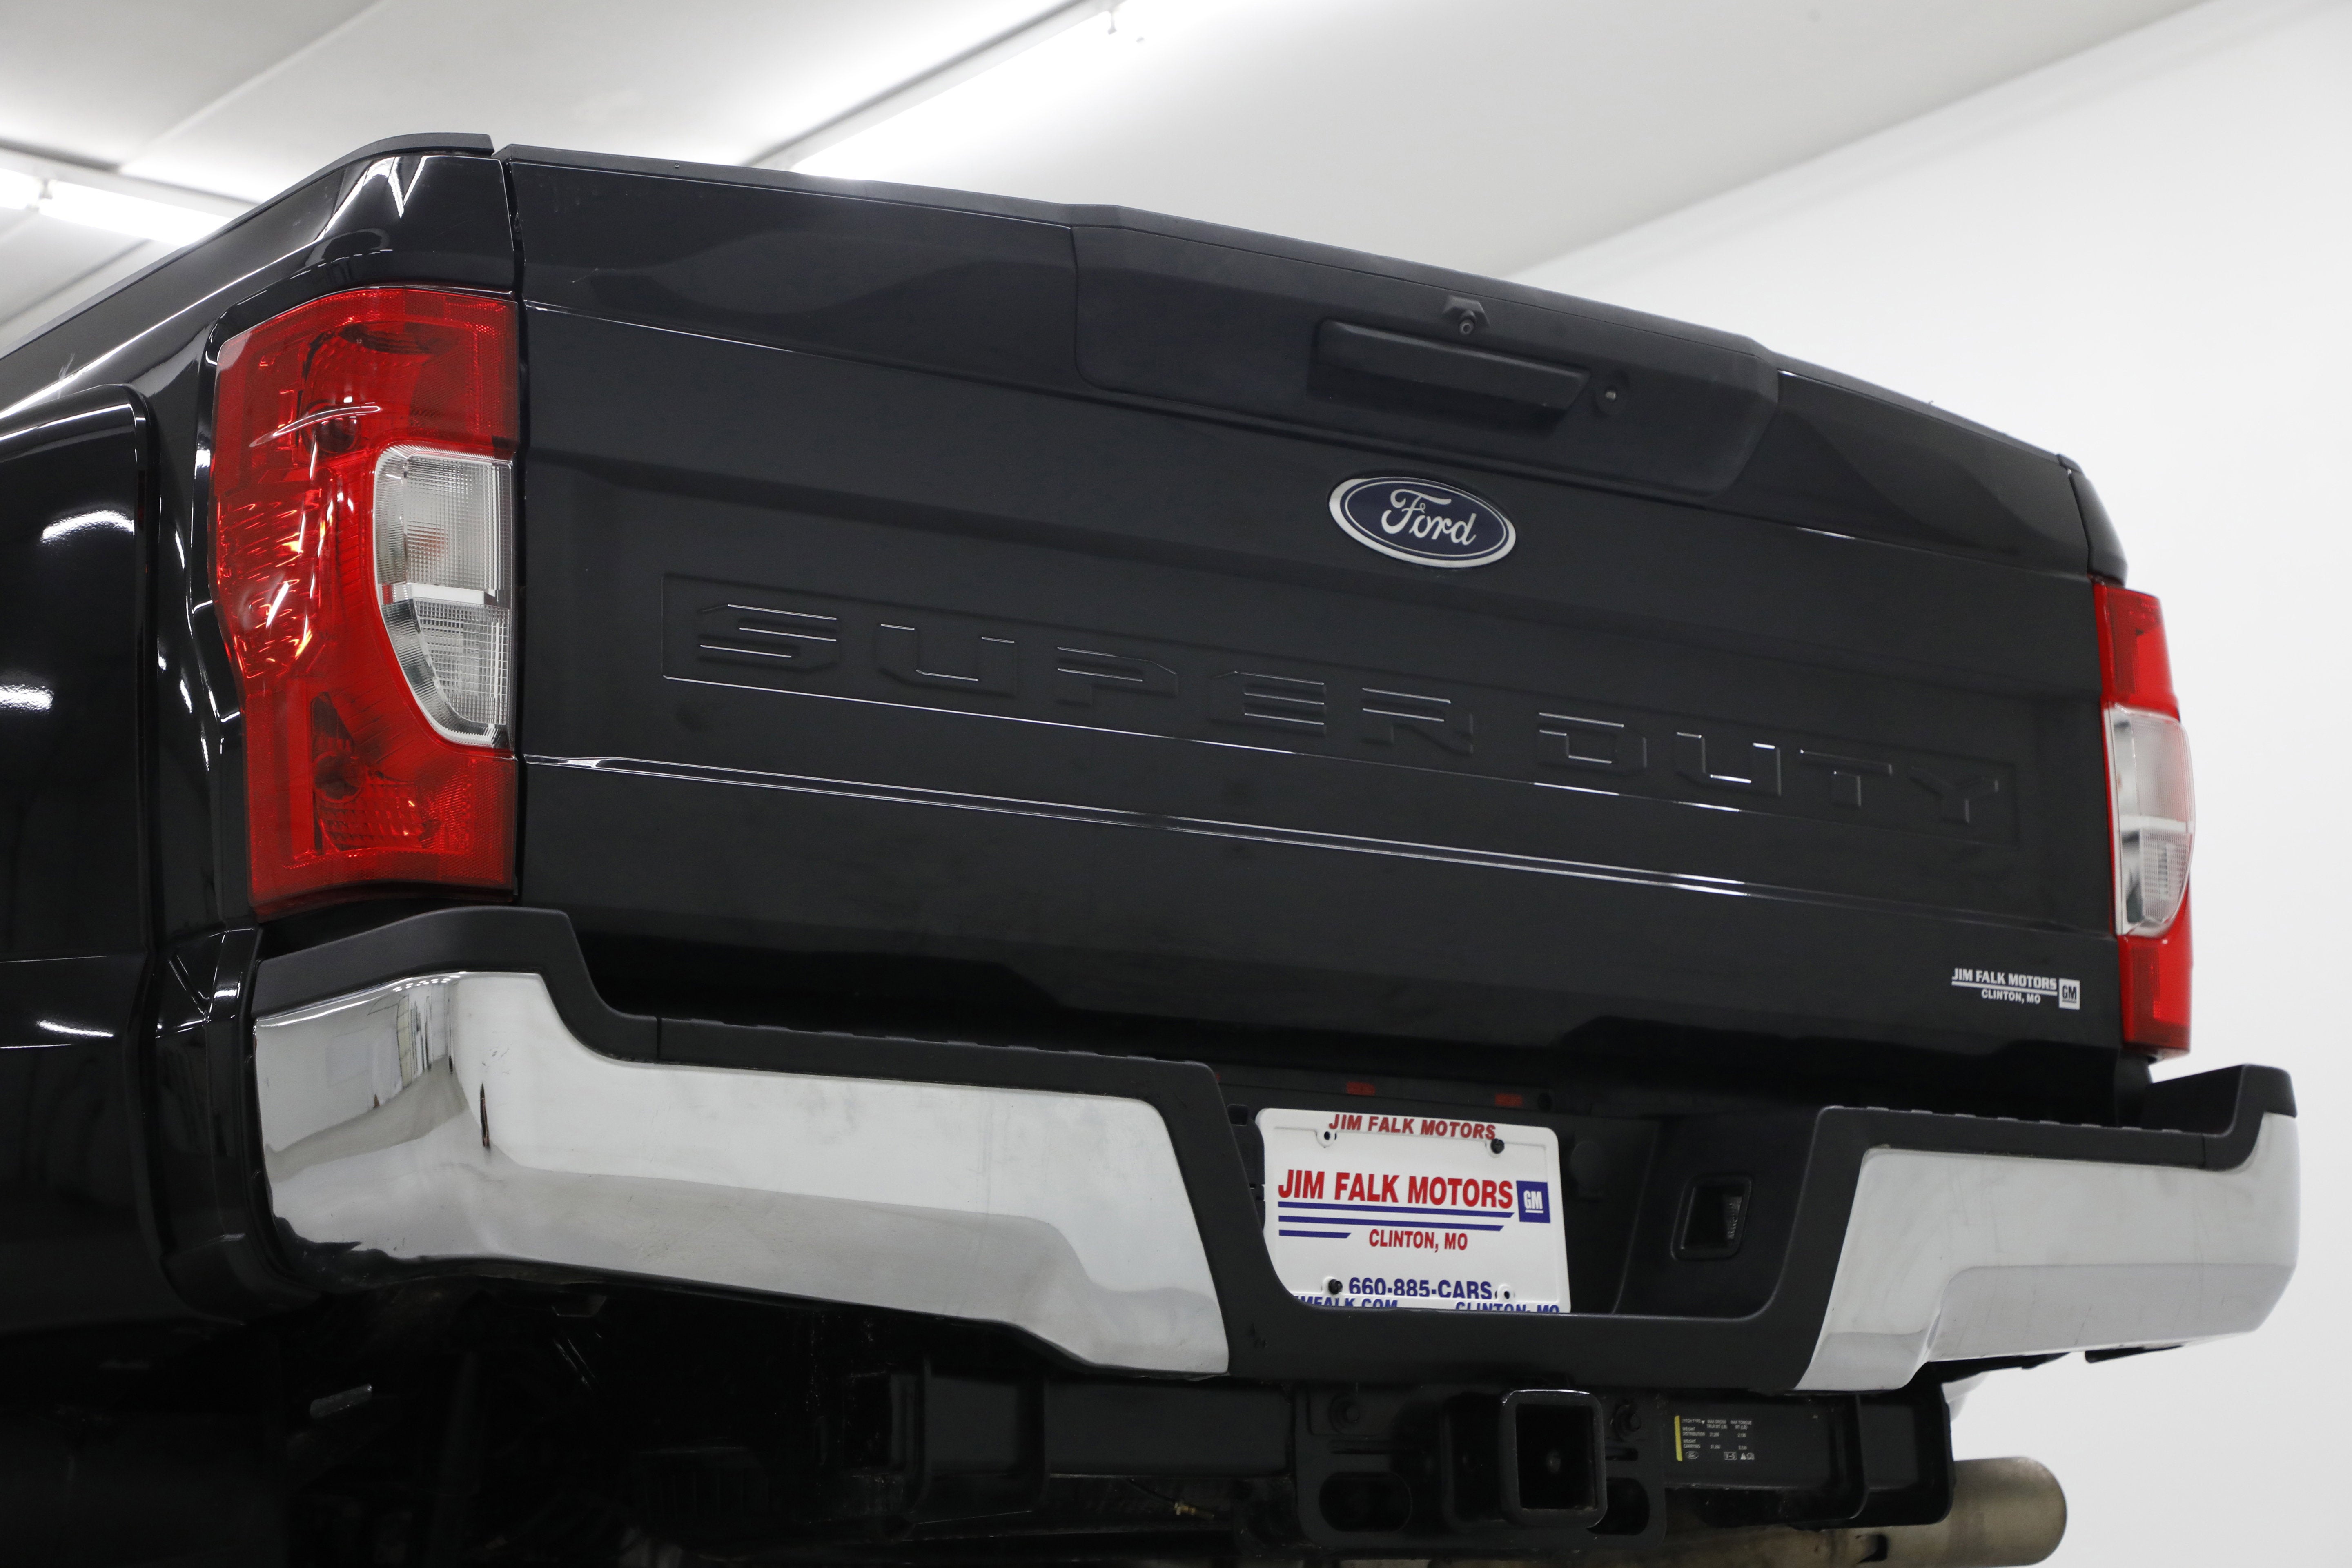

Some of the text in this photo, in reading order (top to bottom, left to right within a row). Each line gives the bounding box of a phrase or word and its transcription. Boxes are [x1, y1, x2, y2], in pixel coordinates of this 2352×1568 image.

[1381, 489, 1477, 546] Ford
[697, 604, 1999, 824] SUPER DUTY
[1951, 967, 2057, 991] JIM FALK MOTORS
[1981, 989, 2041, 1004] CLINTON, MO
[2062, 984, 2077, 1000] GM
[1328, 1114, 1497, 1140] JIM FALK MOTORS
[1278, 1169, 1514, 1209] JIM FALK MOTORS
[1523, 1190, 1544, 1210] GM
[1369, 1229, 1468, 1253] CLINTON, MO
[1349, 1277, 1492, 1299] 660-885-CARS
